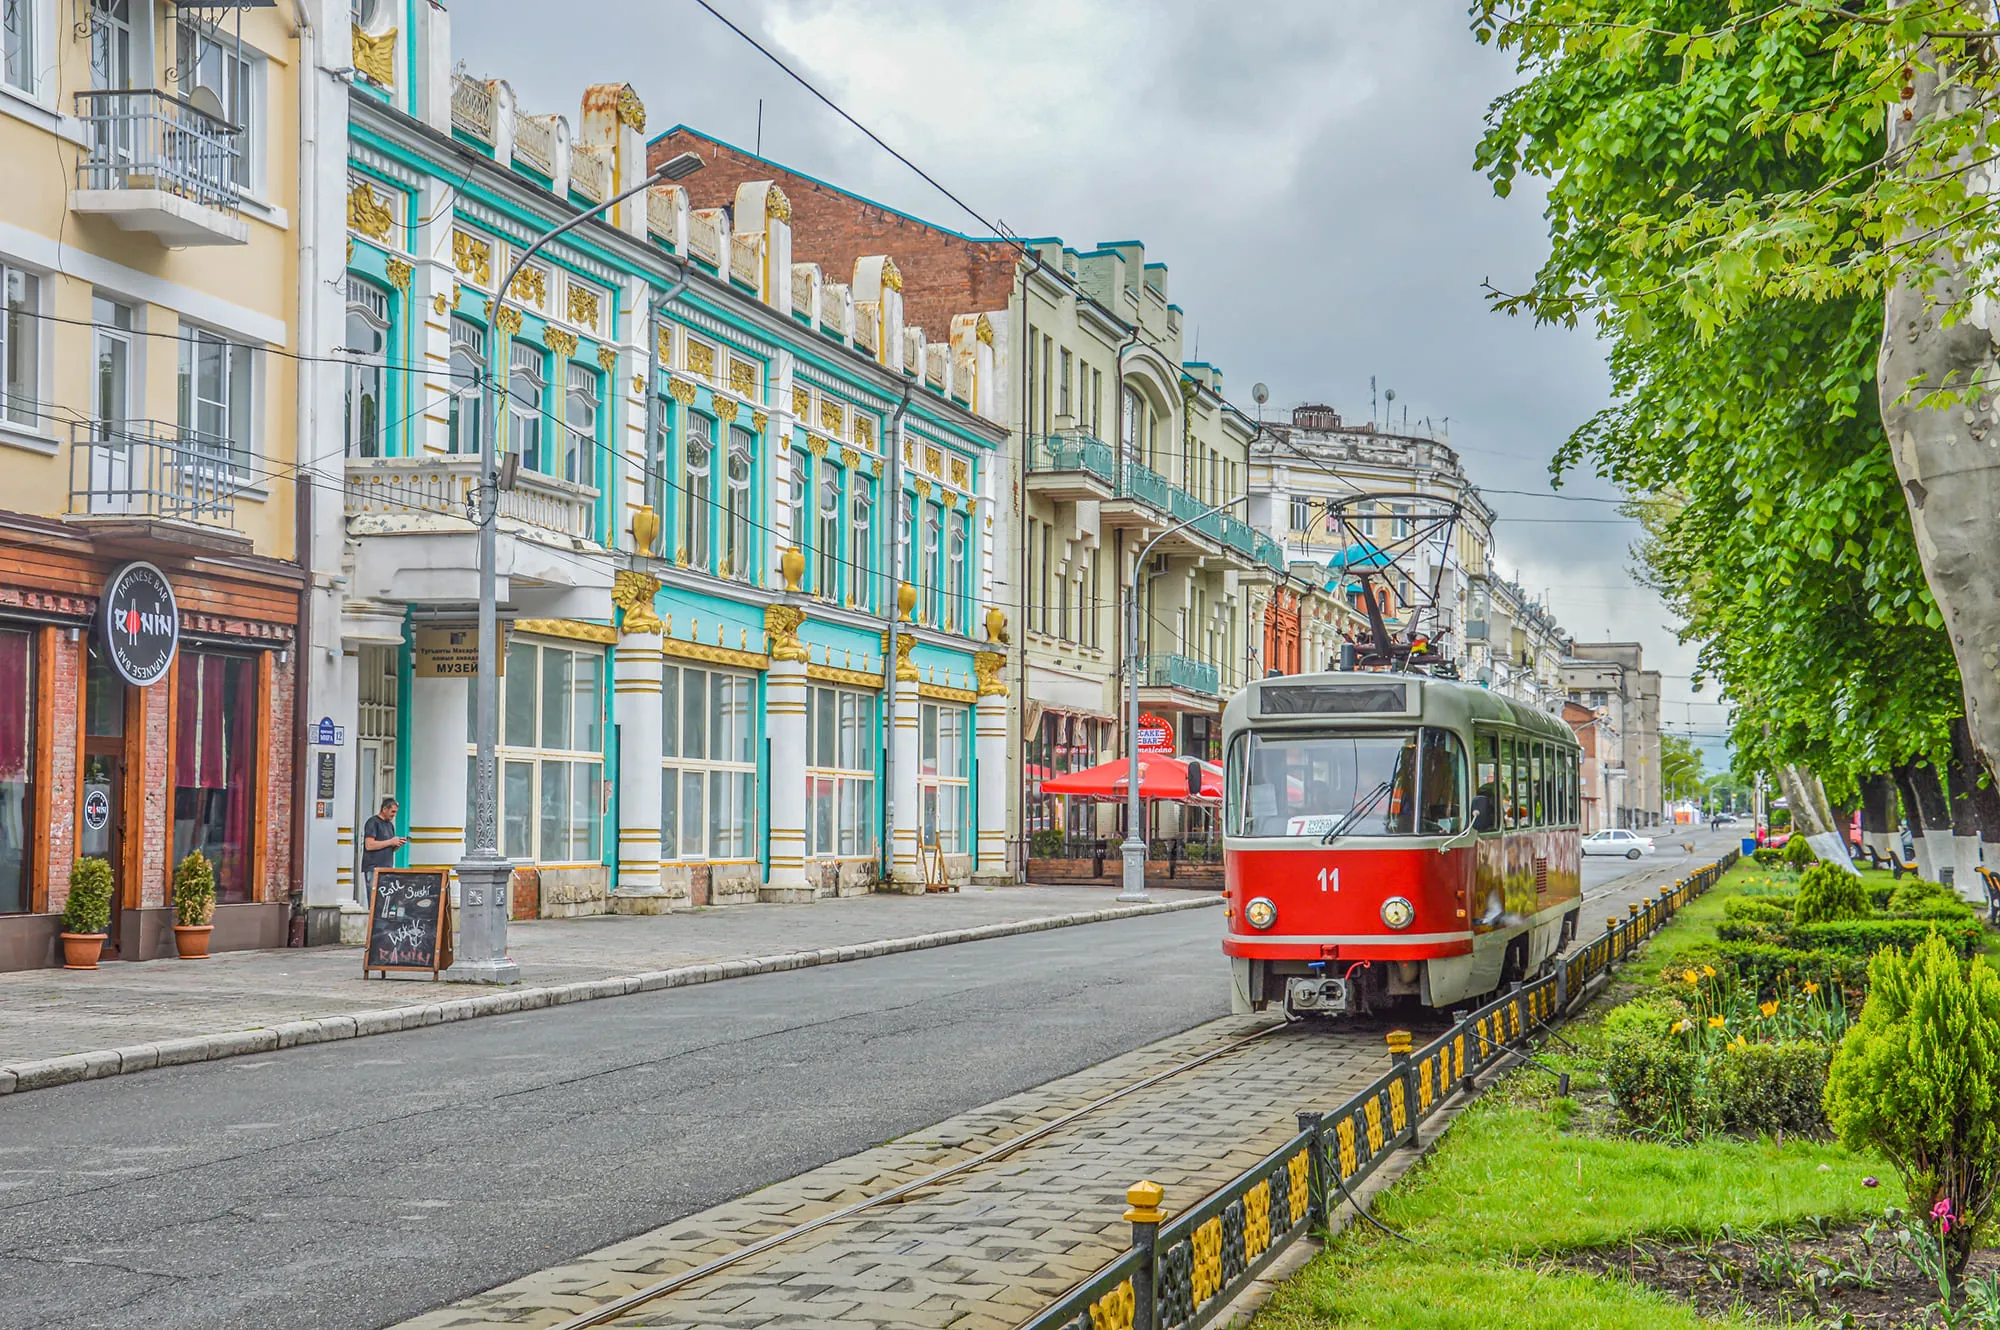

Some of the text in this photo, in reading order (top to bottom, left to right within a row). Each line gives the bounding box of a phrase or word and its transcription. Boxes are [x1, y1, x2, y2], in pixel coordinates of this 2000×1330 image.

[118, 570, 168, 602] JAPANESE BAR
[117, 647, 167, 678] JAPANESE BAR
[437, 661, 478, 673] МУЗЕЙ
[336, 731, 343, 741] 12
[1138, 745, 1173, 753] mericano
[1292, 820, 1306, 836] 7
[1317, 867, 1339, 892] 11
[378, 880, 432, 899] Roll Sushi
